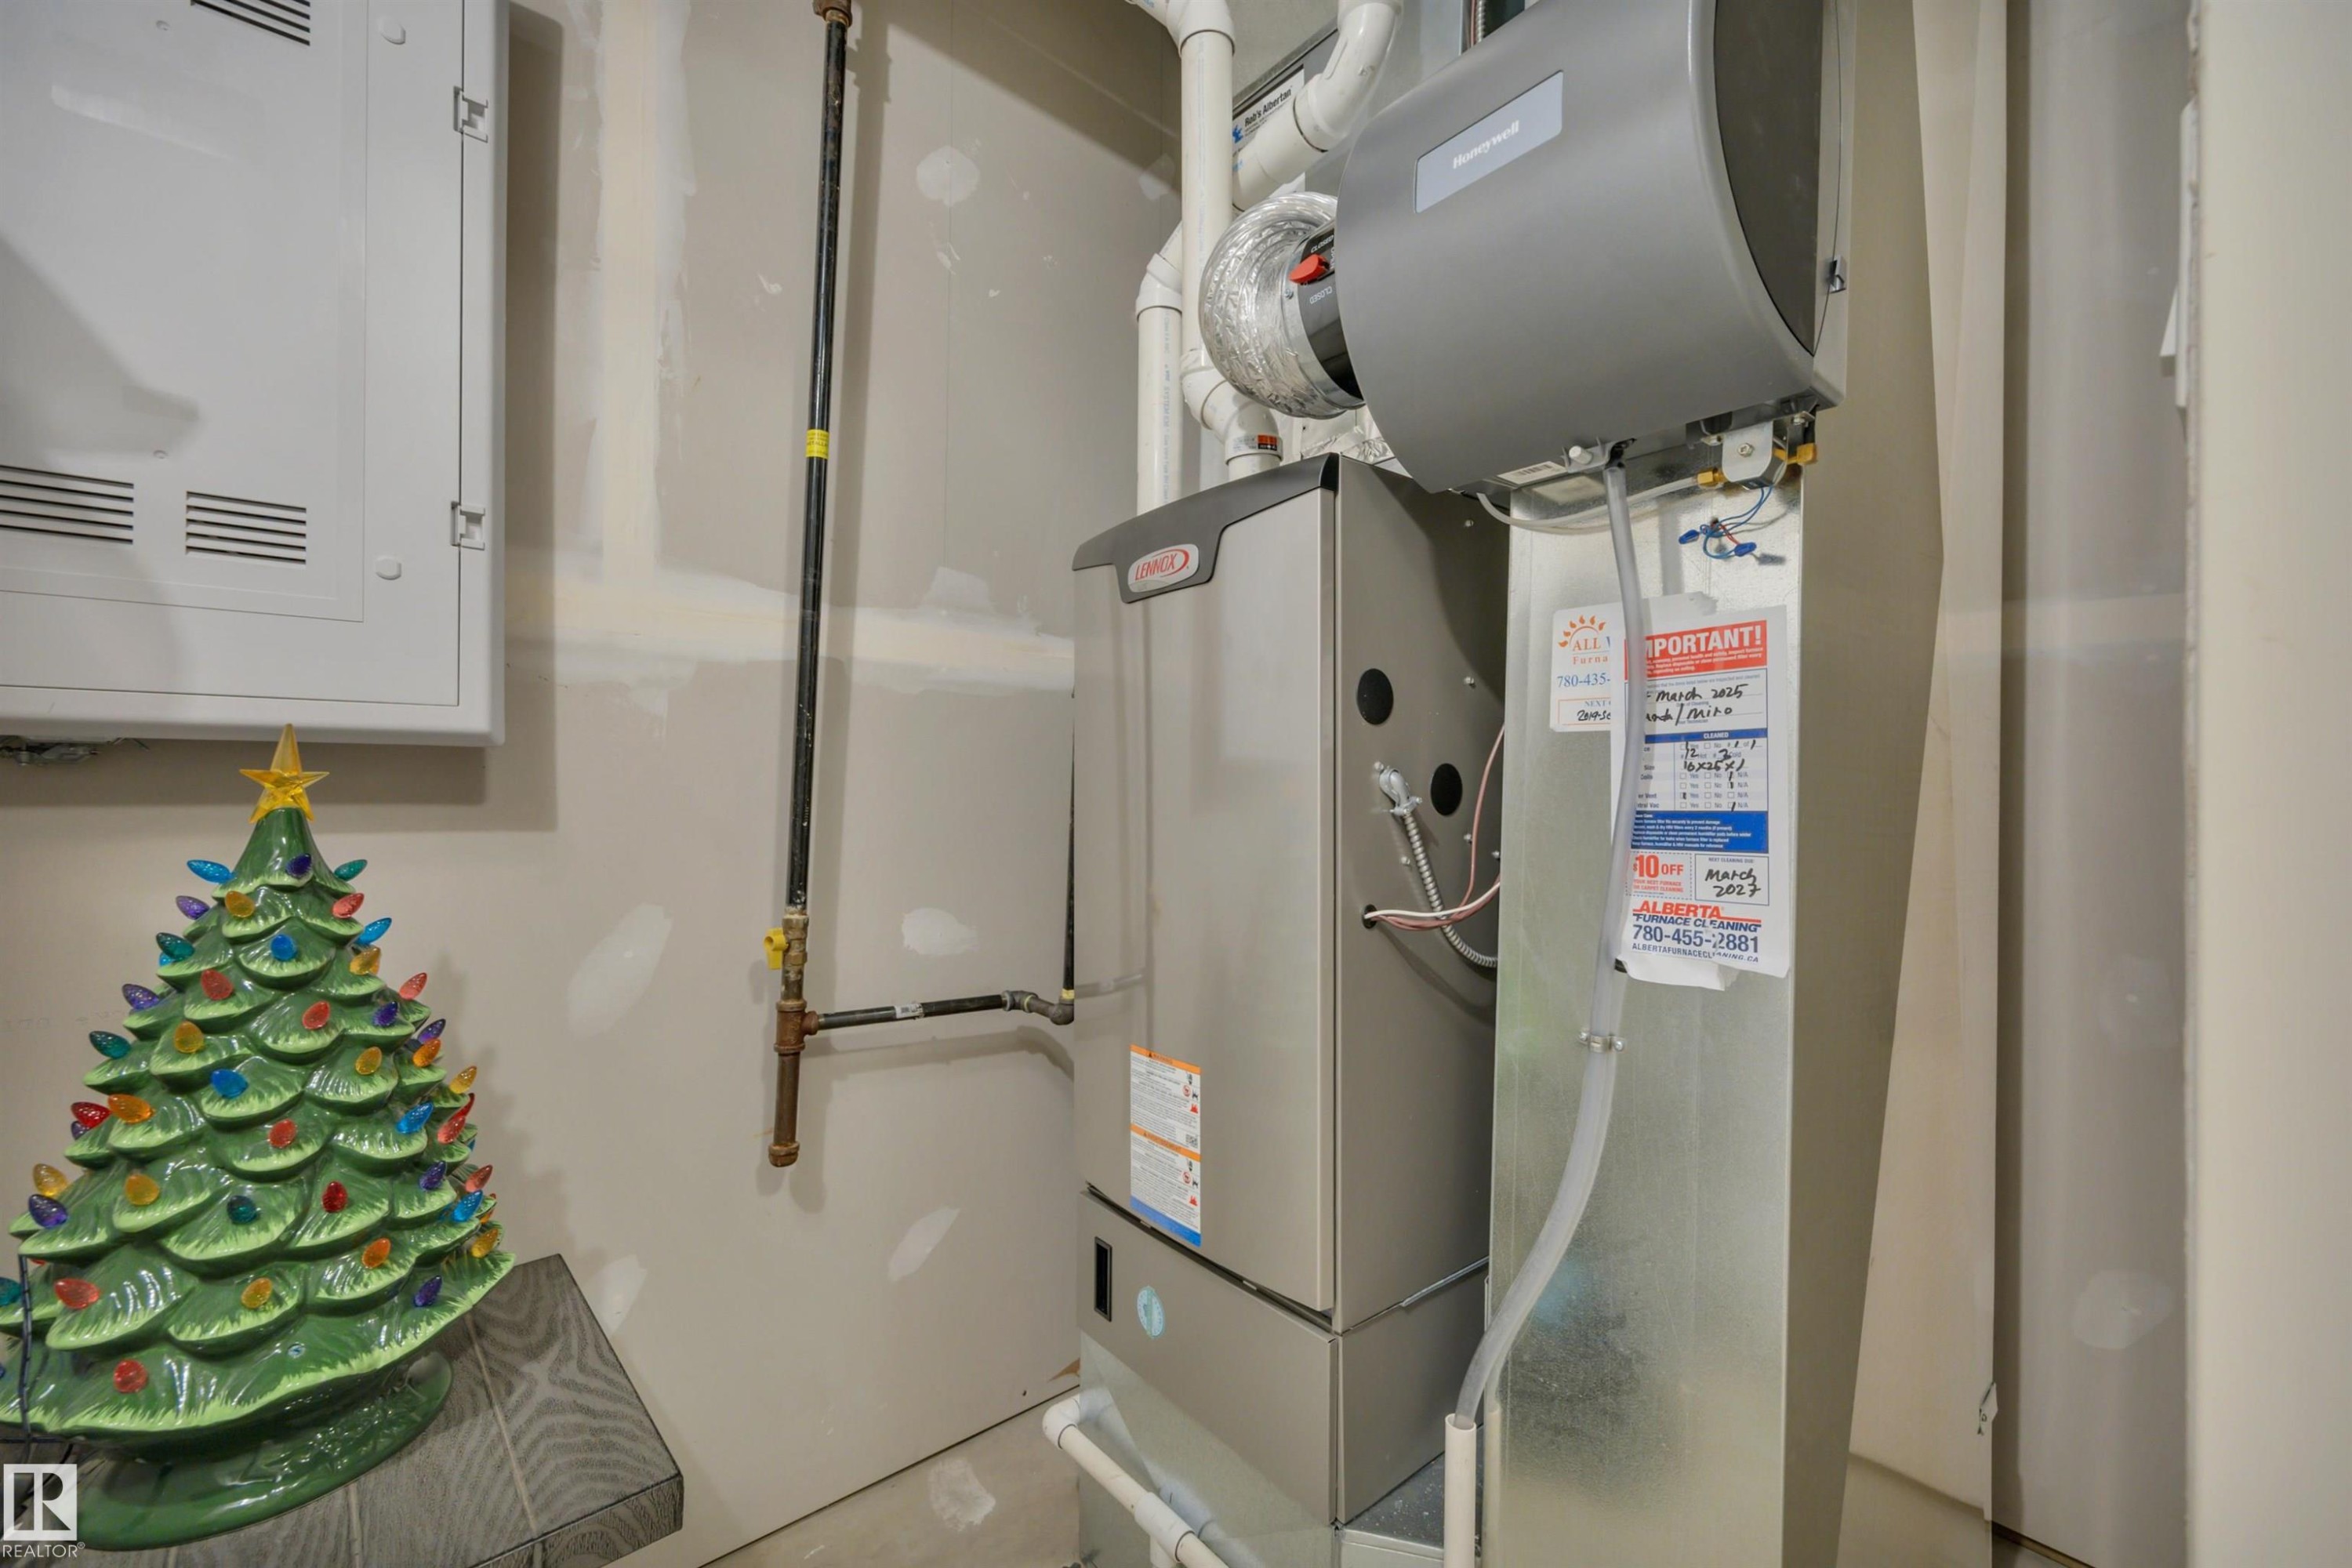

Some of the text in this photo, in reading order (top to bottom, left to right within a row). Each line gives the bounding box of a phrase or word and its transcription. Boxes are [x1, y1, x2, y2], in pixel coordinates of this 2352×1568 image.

[1262, 89, 1292, 115] Albertan
[1453, 120, 1519, 169] Honeywell
[1134, 554, 1178, 581] LENNOX
[1573, 637, 1601, 652] ALL
[1646, 625, 1761, 658] PORTANT!
[1573, 655, 1608, 665] Furna
[1557, 672, 1610, 688] 780-435-
[1711, 684, 1749, 699] 2025
[1661, 863, 1683, 876] OFF
[1713, 884, 1761, 898] 2027
[1637, 899, 1722, 919] ALBERTA
[1633, 913, 1760, 933] FURNACE CLEANING
